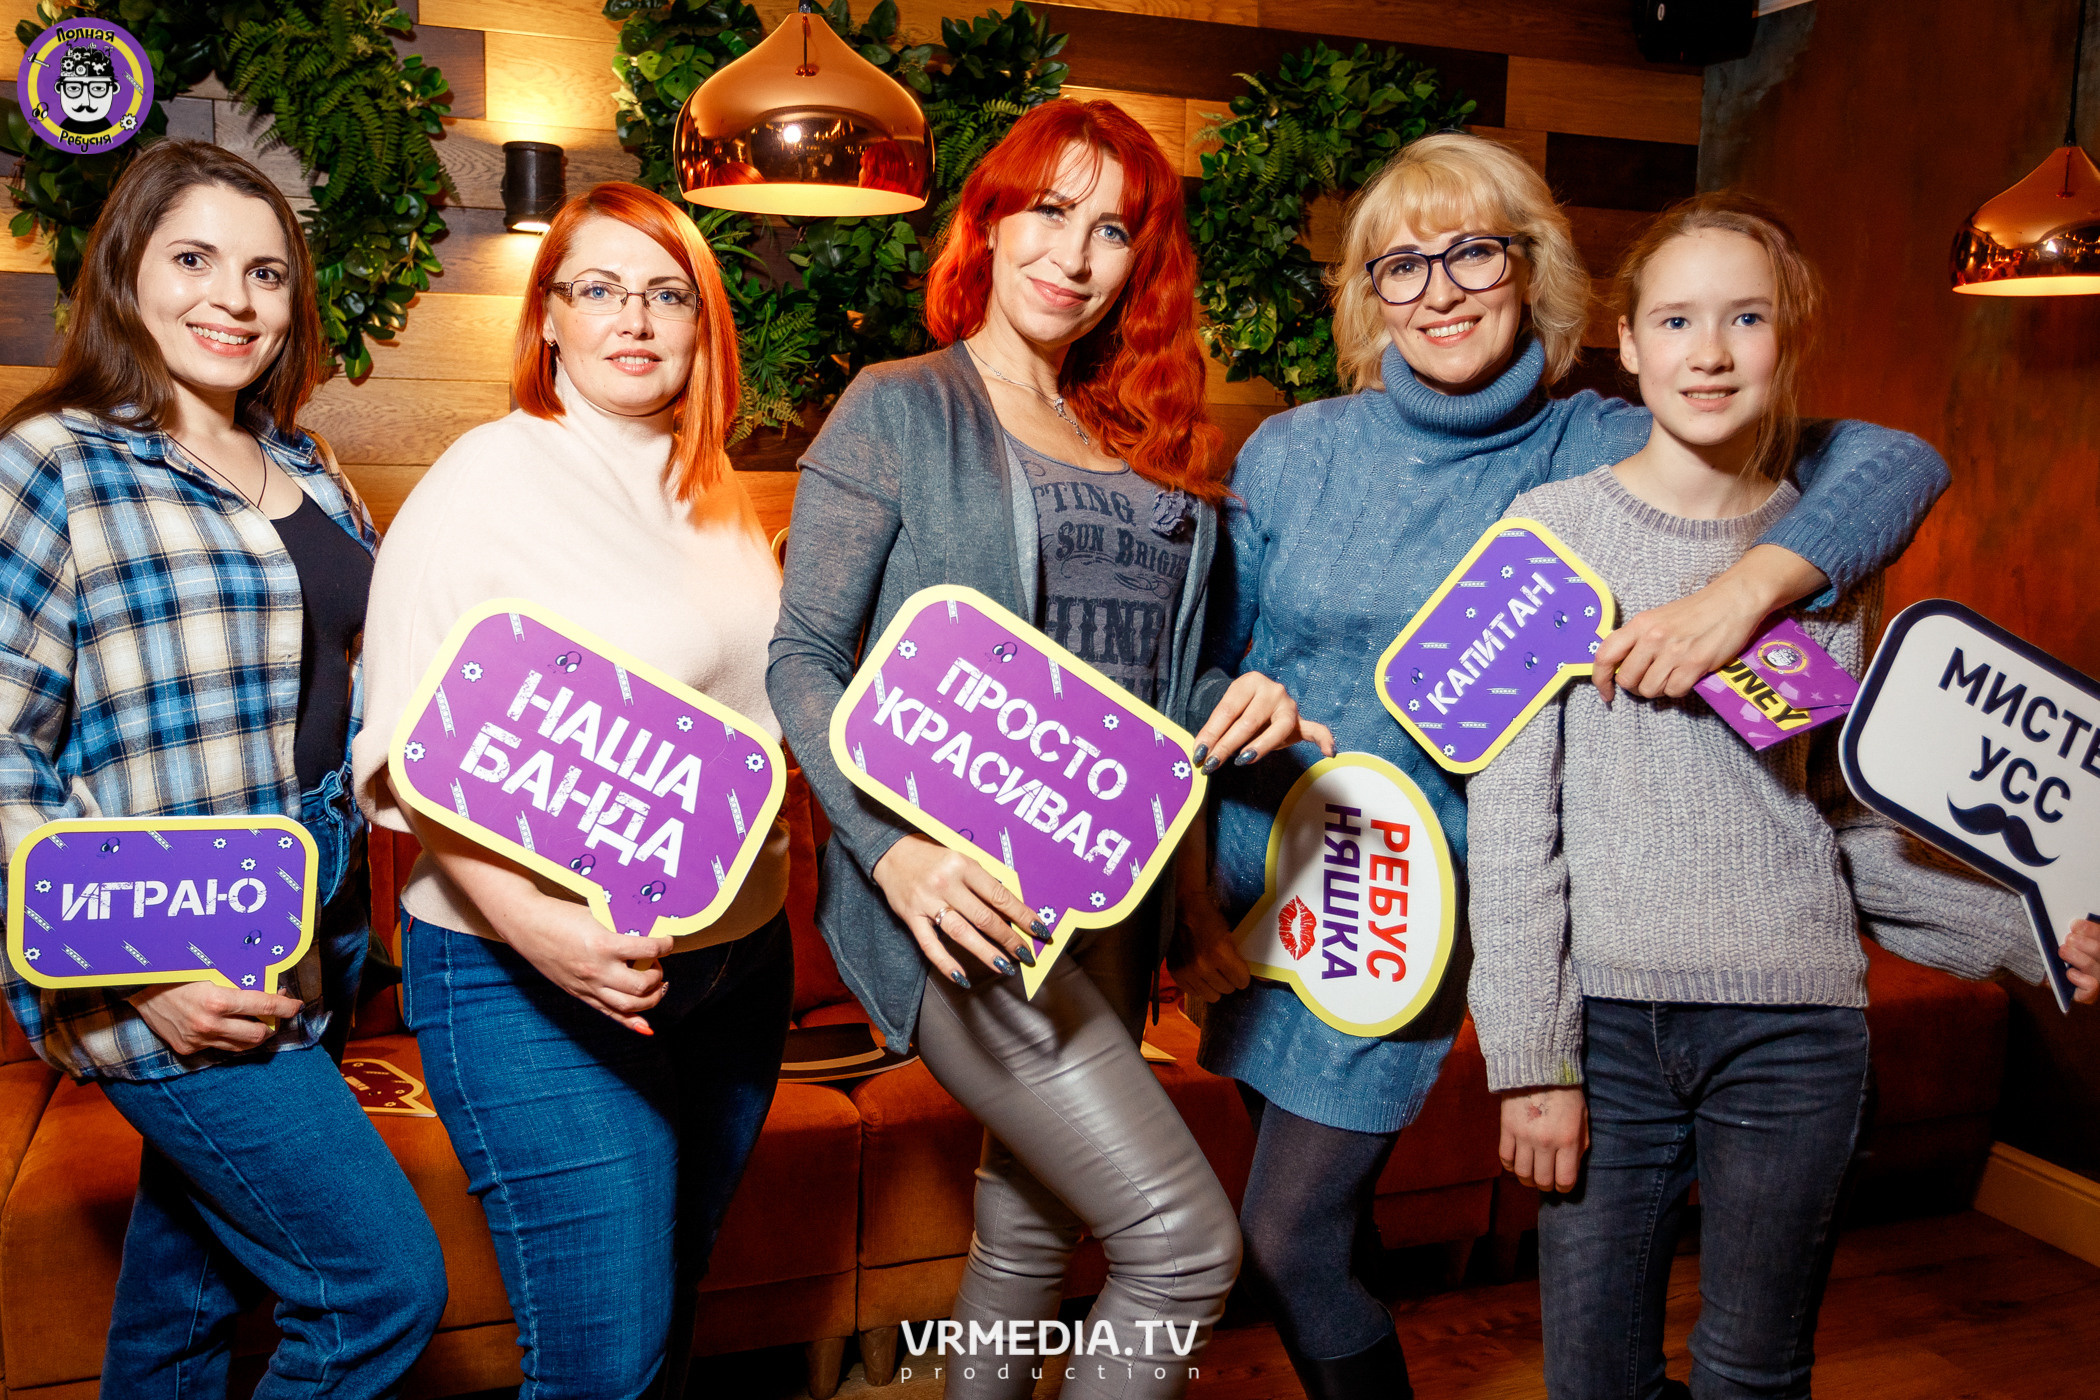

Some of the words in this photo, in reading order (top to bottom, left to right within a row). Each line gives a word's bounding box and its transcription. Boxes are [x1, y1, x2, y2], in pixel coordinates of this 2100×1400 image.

[1033, 481, 1136, 527] TING
[1426, 572, 1555, 715] КАПИТАН
[459, 721, 684, 878] БАНДА
[506, 669, 702, 814] НАША
[873, 686, 1131, 876] КРАСИВАЯ
[936, 657, 1128, 800] ПРОСТО
[1969, 734, 2071, 824] УСС
[62, 877, 267, 921] ИГРАЮ
[1321, 803, 1362, 980] НЯШКА
[1366, 819, 1411, 982] РЕБУС
